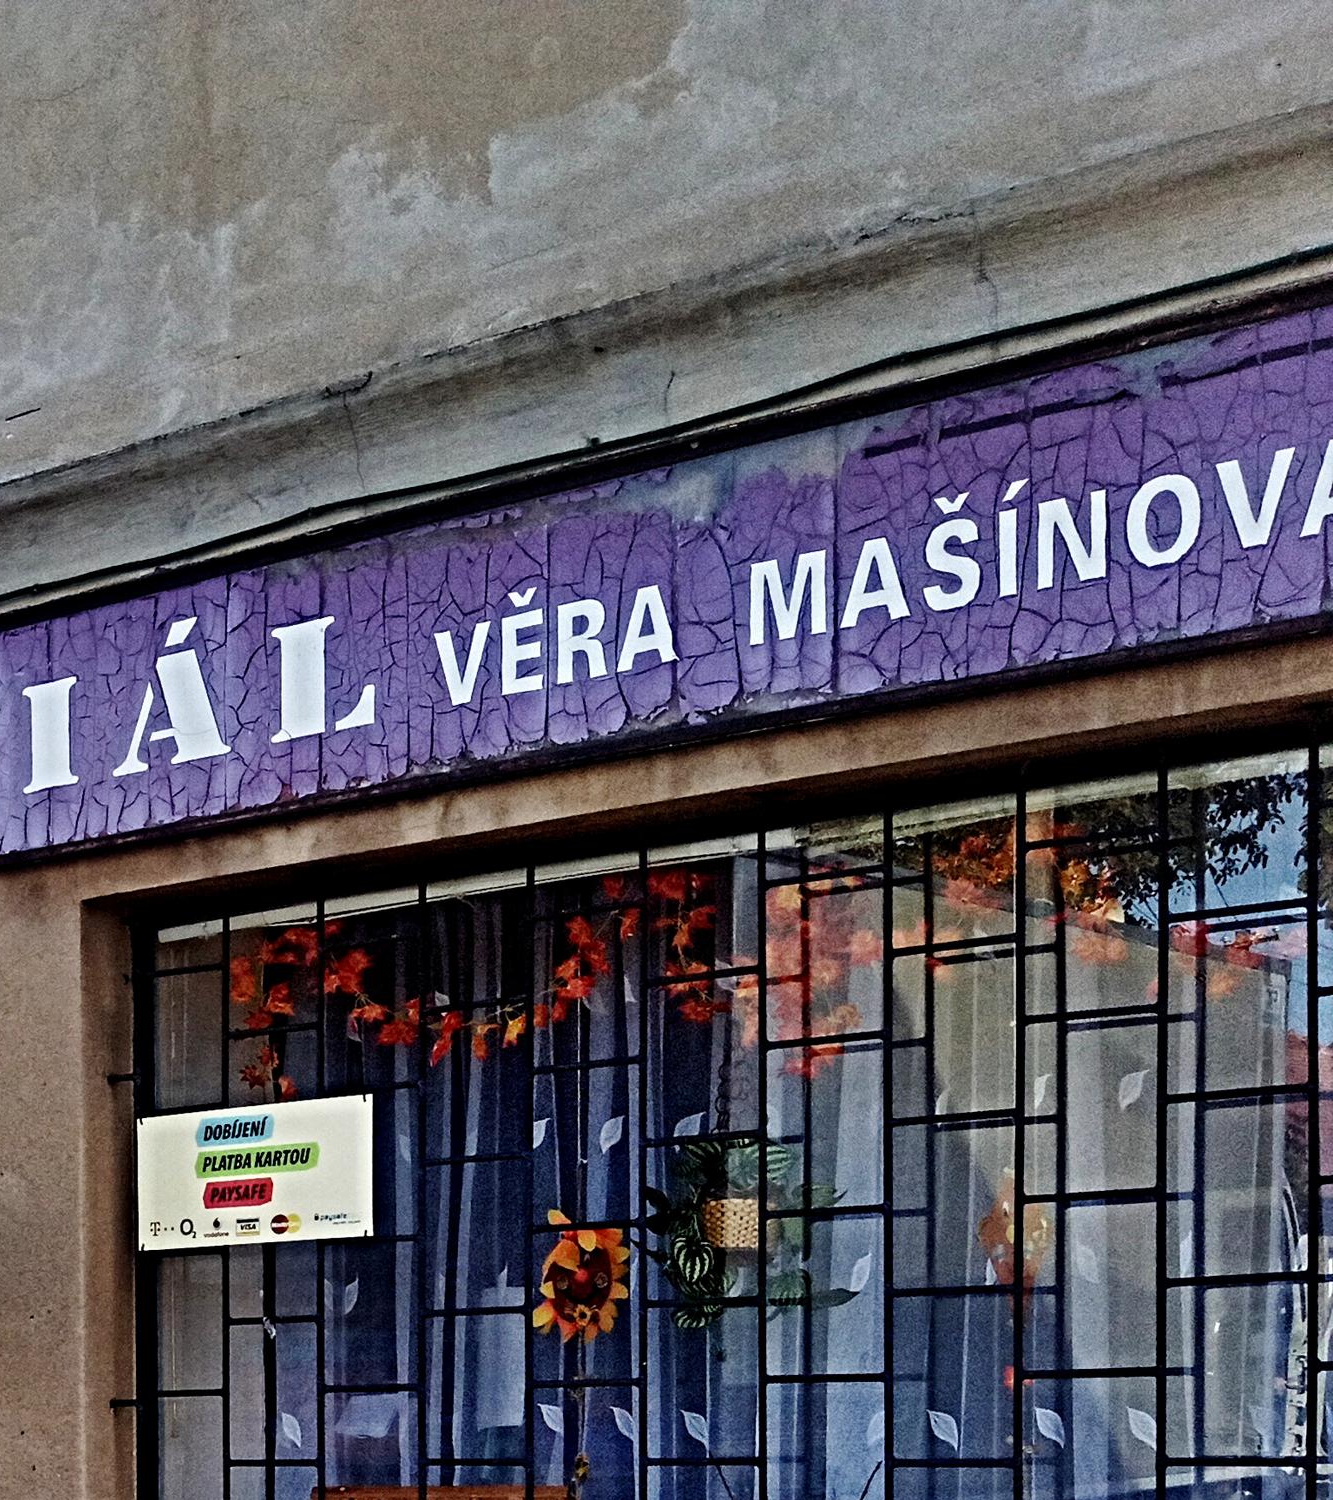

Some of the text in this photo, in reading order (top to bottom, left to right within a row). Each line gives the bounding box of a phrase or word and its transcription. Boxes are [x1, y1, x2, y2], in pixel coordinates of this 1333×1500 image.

[434, 587, 679, 706] VĚRA
[203, 1116, 268, 1141] DOBÍJENÍ
[202, 1147, 311, 1172] PLATBA KARTOU
[209, 1183, 268, 1203] PAYSAFE
[239, 1223, 257, 1231] VISA
